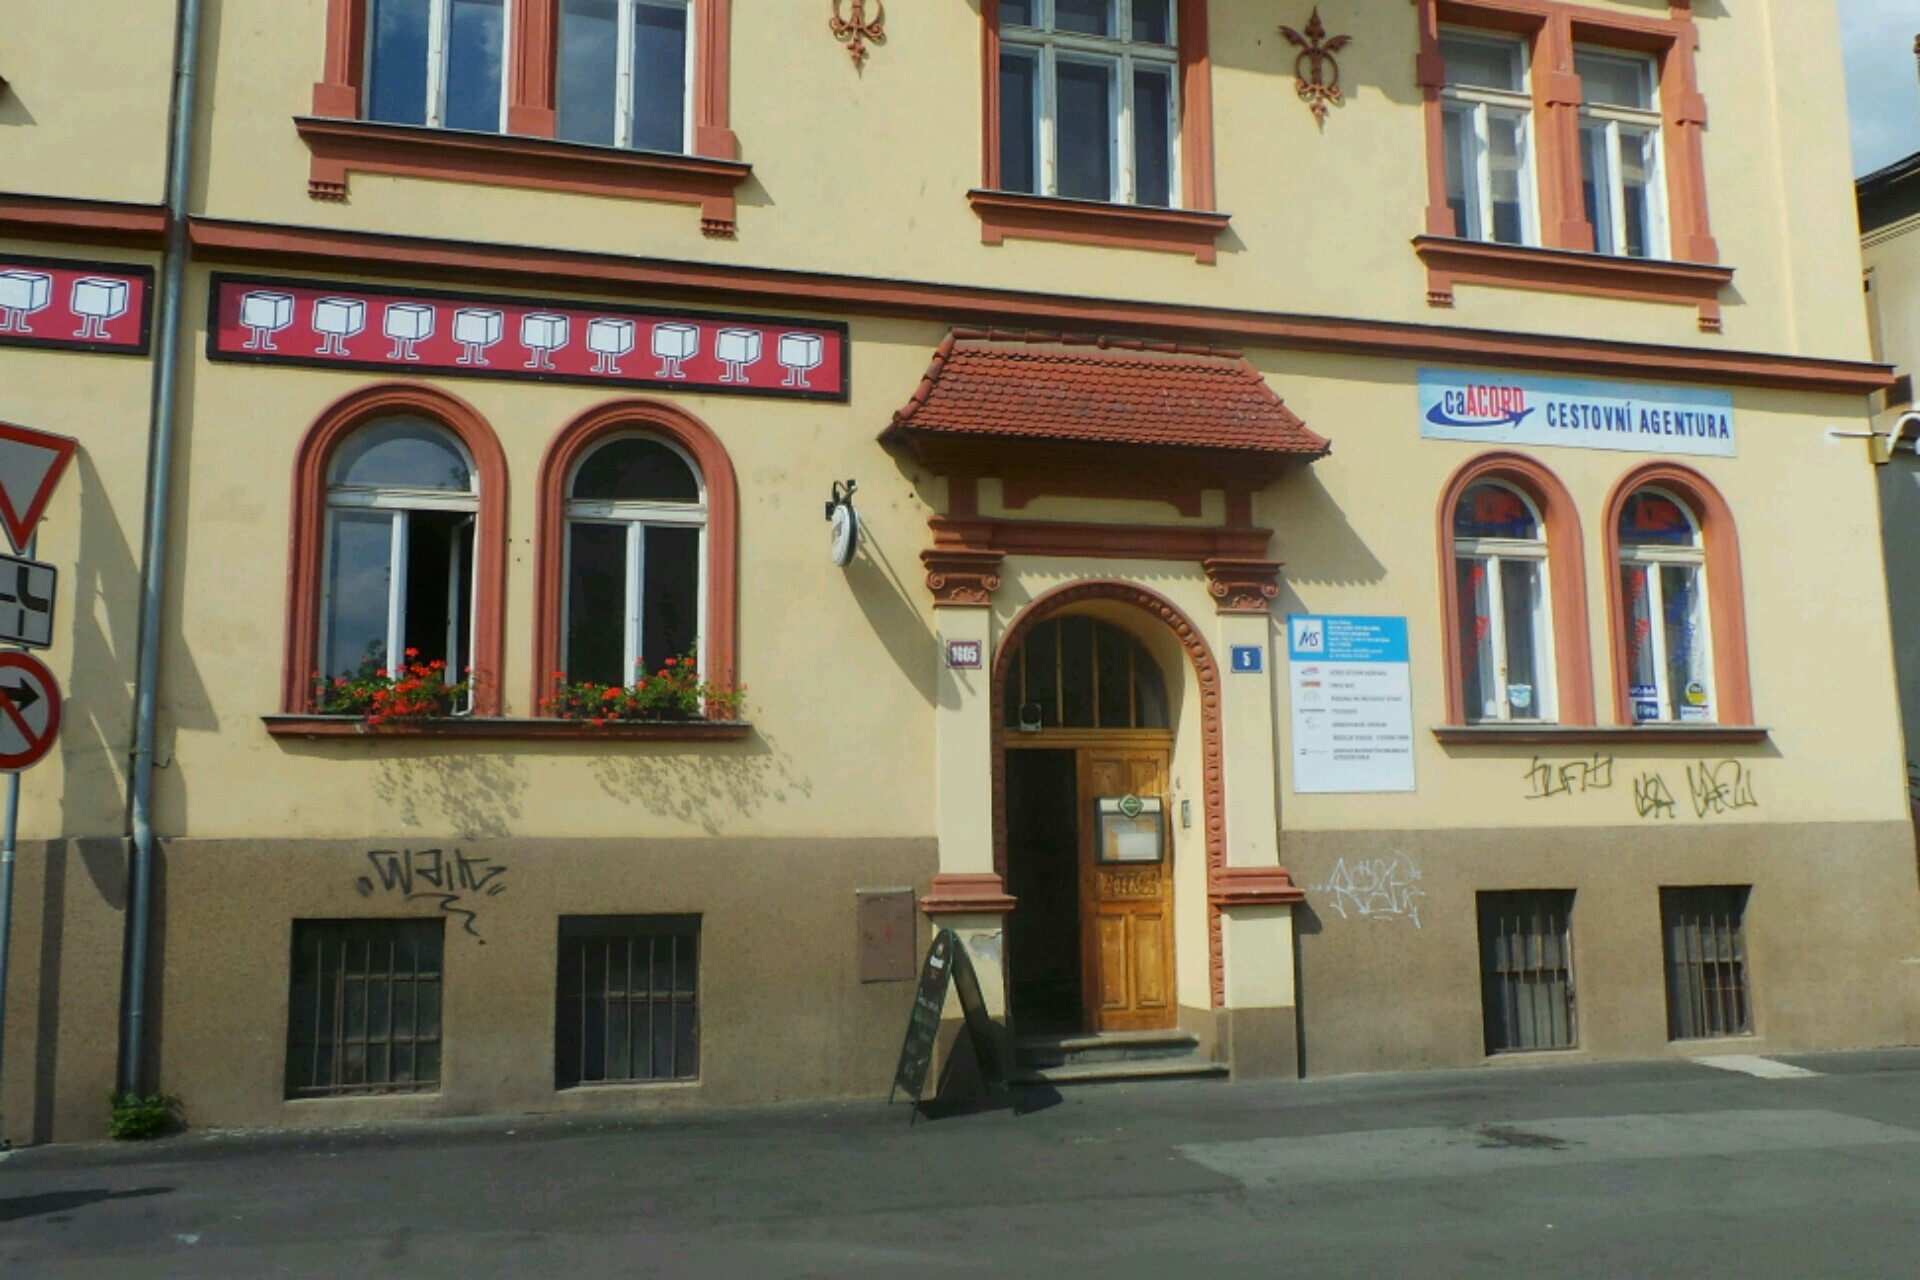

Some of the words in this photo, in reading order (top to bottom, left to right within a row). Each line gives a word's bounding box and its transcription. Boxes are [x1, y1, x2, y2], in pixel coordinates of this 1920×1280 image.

[1547, 401, 1632, 433] CESTOVNÍ
[1639, 405, 1729, 439] AGENTURA
[1242, 651, 1252, 667] 5
